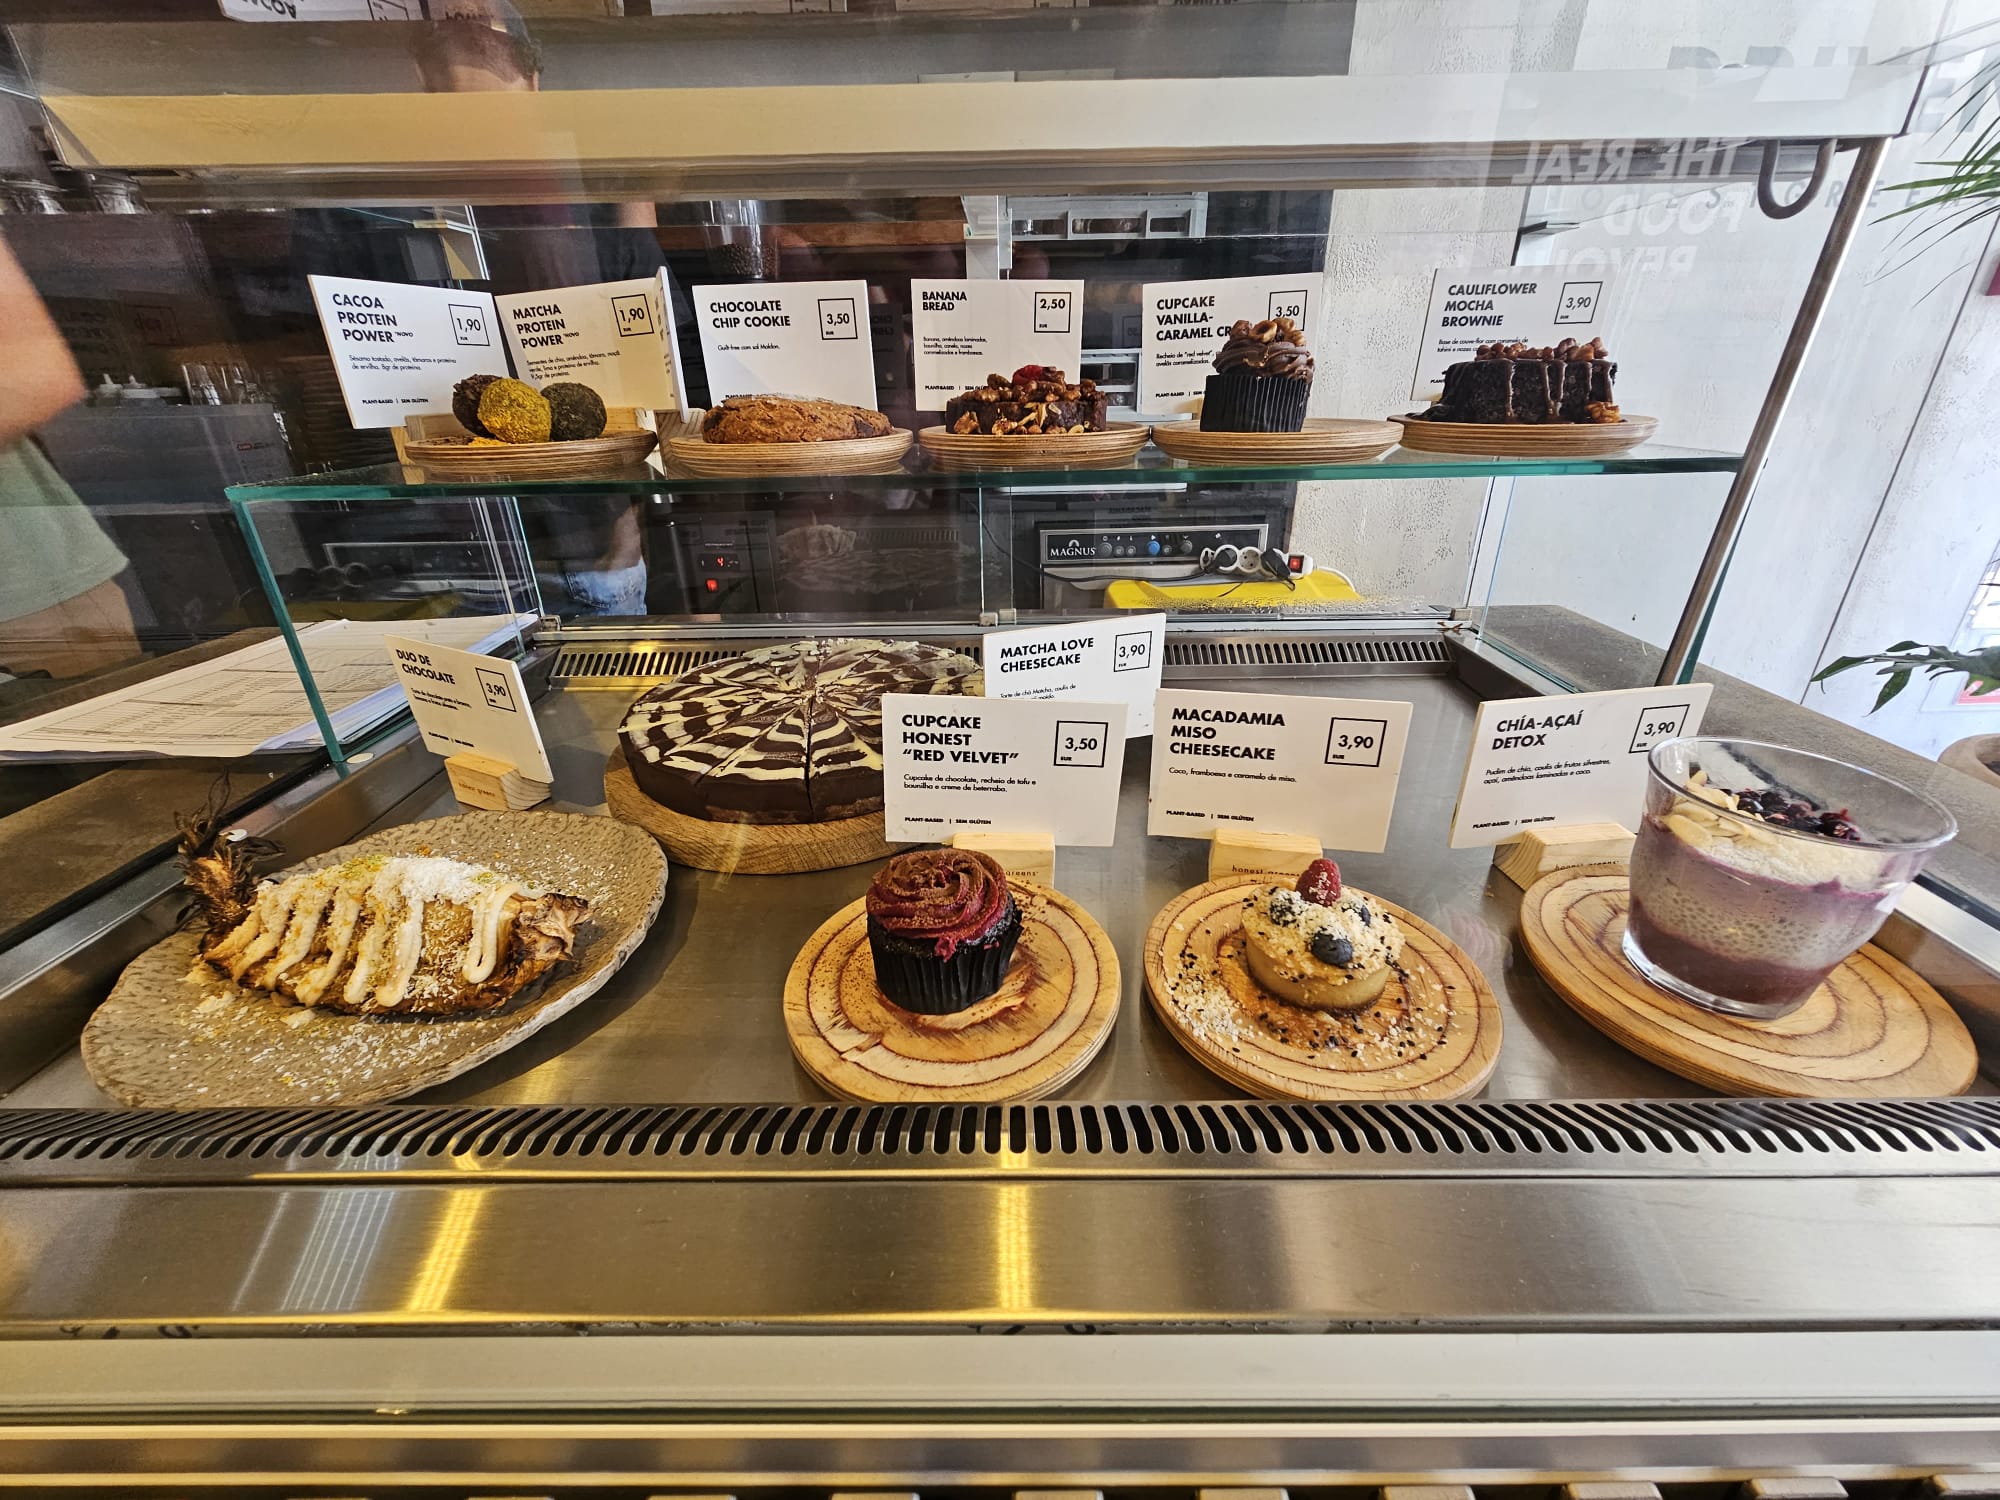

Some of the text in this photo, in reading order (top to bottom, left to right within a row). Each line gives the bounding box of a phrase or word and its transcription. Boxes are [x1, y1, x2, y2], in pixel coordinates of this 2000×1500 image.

[922, 291, 967, 301] BANANA
[1448, 283, 1538, 296] CAULIFLOWER
[332, 293, 385, 309] CACOA
[710, 300, 782, 313] CHOCOLATE
[922, 302, 955, 311] BREAD
[1039, 298, 1066, 310] 2,50
[1157, 296, 1215, 310] CUPCAKE
[1444, 300, 1494, 311] MOCHA
[1565, 297, 1592, 310] 3,90
[337, 311, 397, 326] PROTEIN
[513, 304, 562, 320] MATCHA
[619, 307, 645, 323] 1,90
[826, 312, 850, 326] 3,50
[1156, 312, 1213, 326] VANILLA-
[1275, 304, 1300, 319] 3,50
[456, 318, 481, 332] 1,90
[516, 319, 566, 335] PROTEIN
[712, 315, 791, 328] CHIP COOKIE
[1441, 315, 1504, 327] BROWNIE
[342, 329, 394, 342] POWER
[1156, 326, 1213, 341] CARAMEL
[520, 335, 564, 349] POWER
[1050, 547, 1097, 556] MAGNUS
[1000, 637, 1094, 659] MATCHA LOVE
[1118, 643, 1146, 659] 3,90
[396, 649, 432, 666] DUO DE
[1000, 653, 1081, 673] CHEESECAKE
[402, 663, 456, 685] CHOCOLATE
[486, 682, 507, 697] 3,90
[902, 714, 981, 729] CUPCAKE
[1172, 707, 1286, 726] MACADAMIA
[1496, 710, 1585, 732] CHÍA-AÇAÍ
[1170, 725, 1217, 740] MISO
[1643, 721, 1675, 736] 3,90
[902, 732, 972, 746] HONEST
[1065, 737, 1098, 752] 3,50
[1337, 735, 1374, 750] 3,90
[1492, 734, 1547, 750] DETOX
[902, 749, 1019, 764] "RED VELVET"
[1169, 742, 1276, 761] CHEESECAKE
